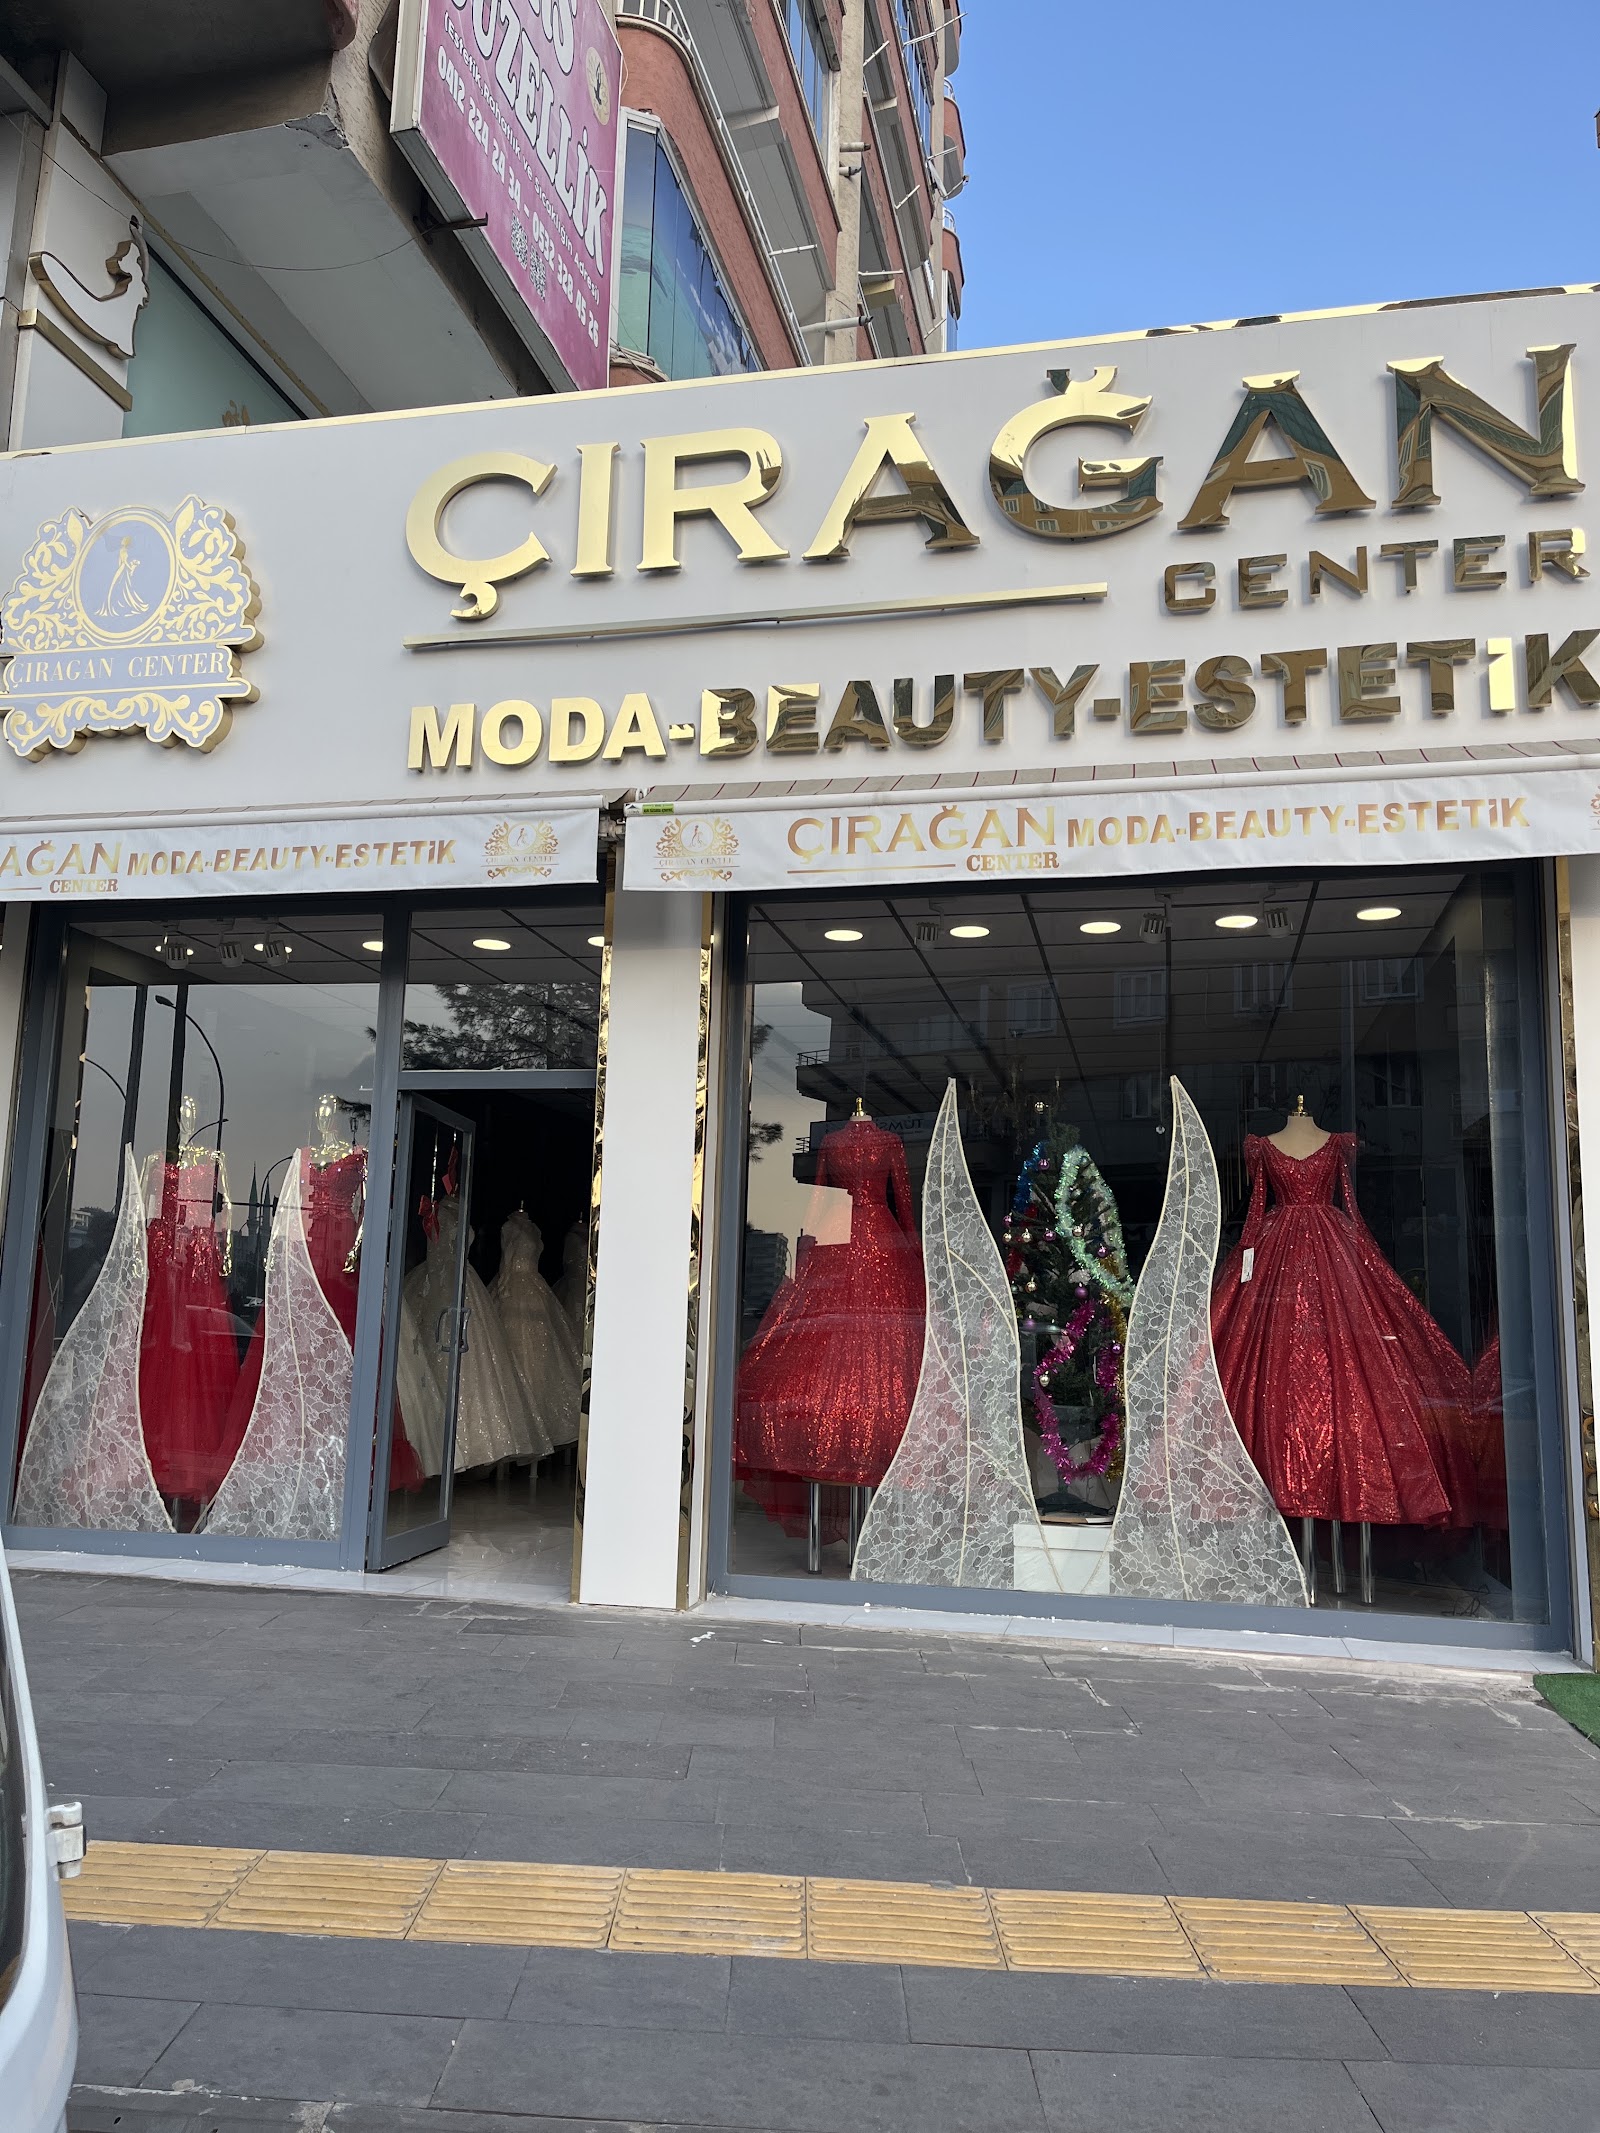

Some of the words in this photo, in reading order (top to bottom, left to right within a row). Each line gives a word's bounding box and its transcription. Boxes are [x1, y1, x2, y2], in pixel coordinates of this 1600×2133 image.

[438, 45, 465, 115] 0412
[468, 97, 489, 155] 224
[492, 138, 506, 185] 24
[509, 166, 521, 211] 34
[532, 211, 555, 272] 0532
[557, 253, 574, 304] 328
[575, 289, 587, 326] 45
[588, 310, 599, 348] 26
[405, 343, 1586, 621] ÇIRAĞAN
[1164, 527, 1591, 614] CENTER
[128, 651, 226, 677] CENTER
[787, 805, 1057, 864] ÇIRAĞAN
[966, 851, 1060, 873] CENTER
[49, 879, 118, 894] CENTER
